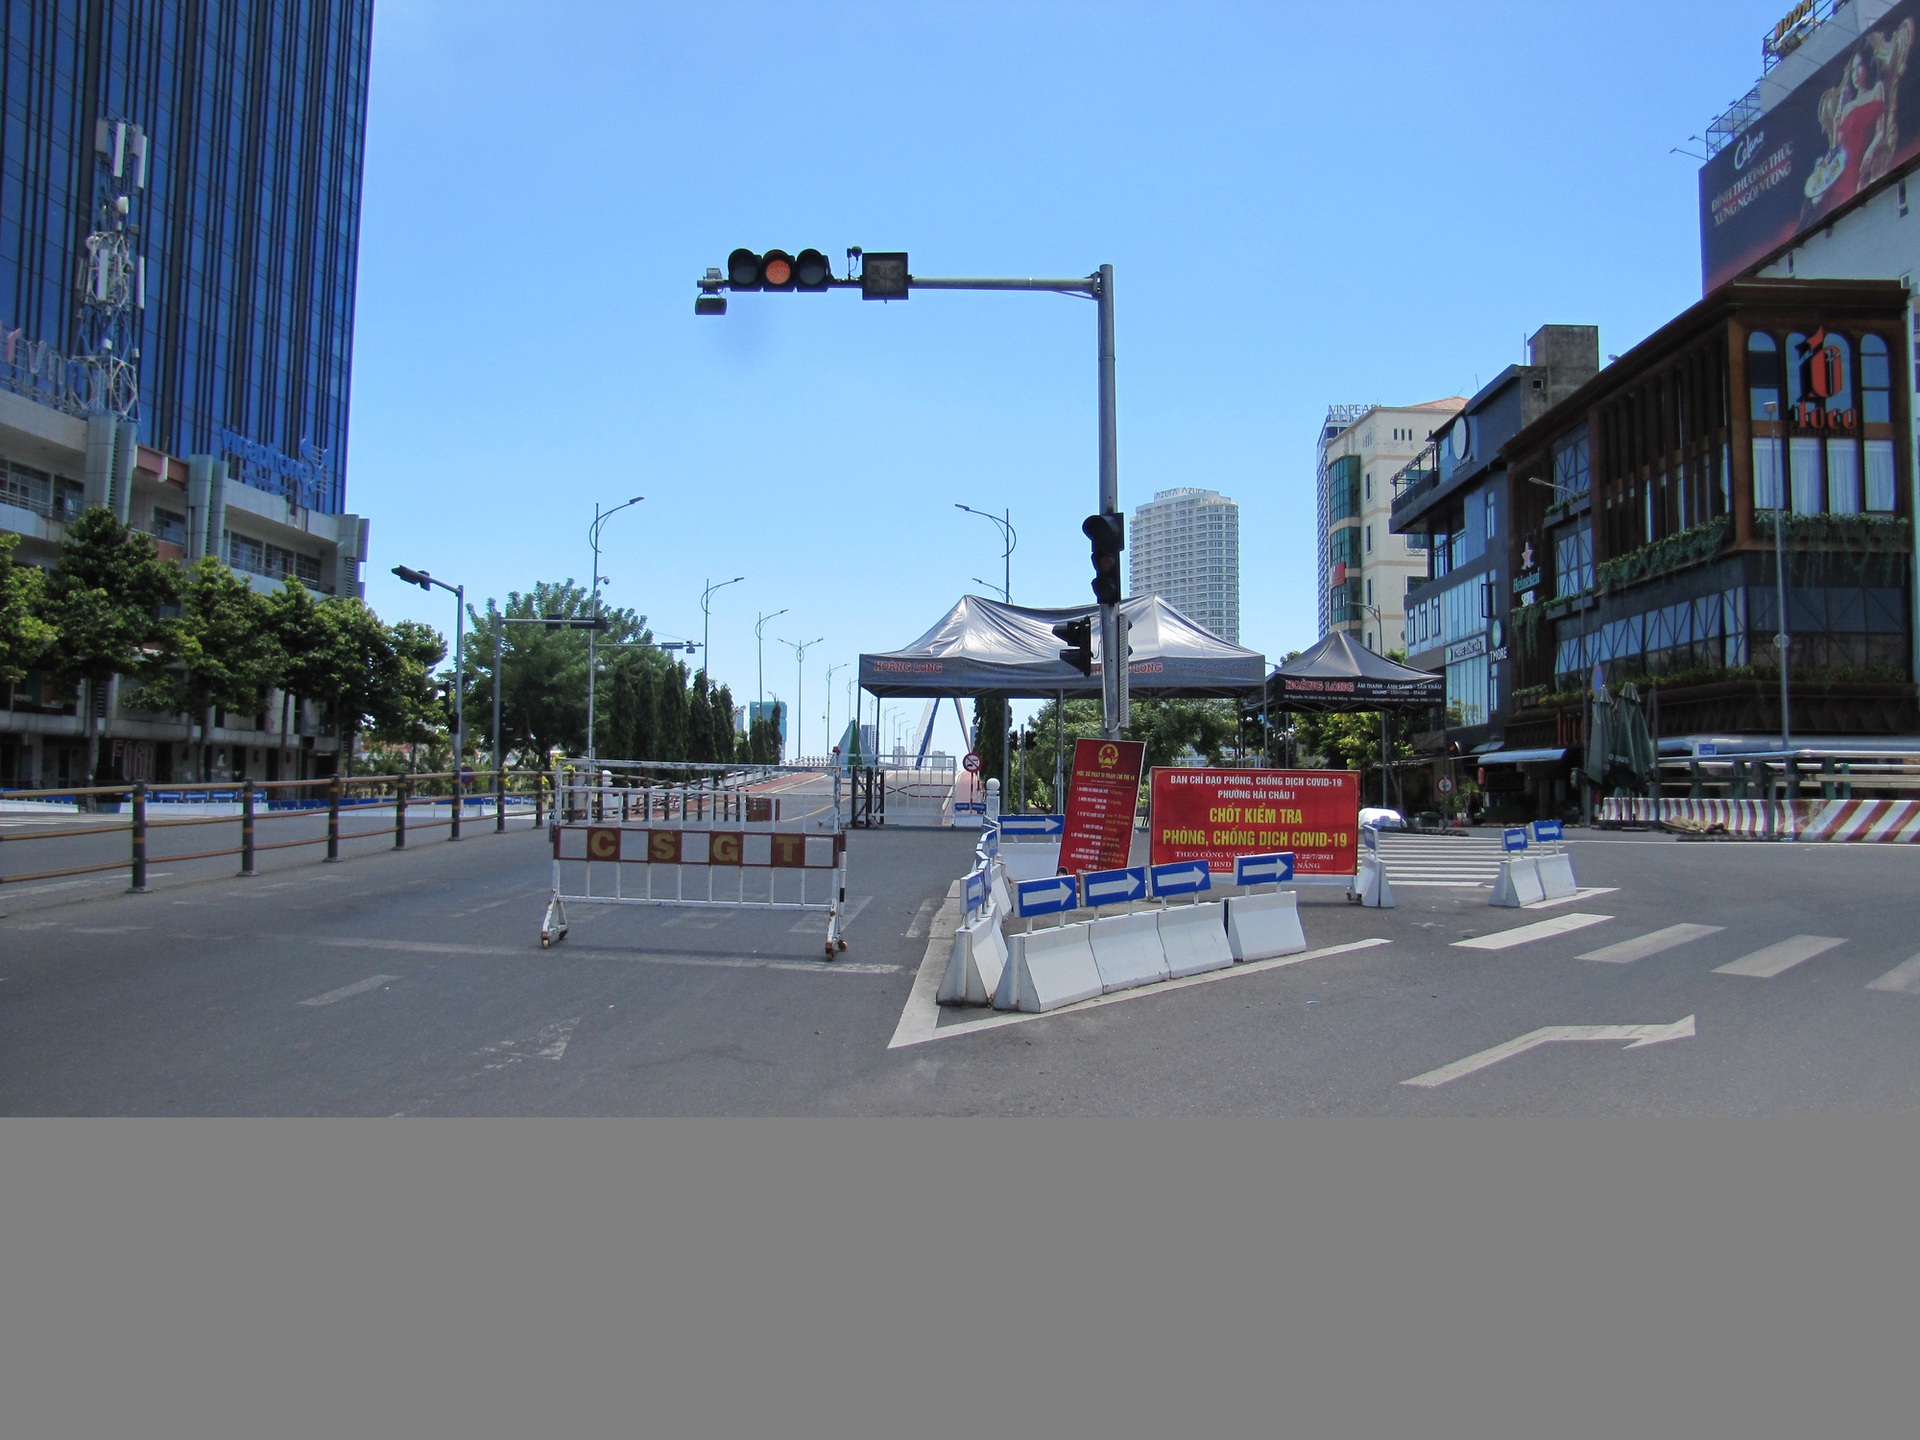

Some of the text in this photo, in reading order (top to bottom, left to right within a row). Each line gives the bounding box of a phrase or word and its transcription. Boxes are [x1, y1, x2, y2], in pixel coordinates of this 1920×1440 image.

[1513, 567, 1540, 593] Heineken
[874, 661, 911, 672] HOÀNG
[913, 662, 942, 672] LONG
[1133, 663, 1163, 673] LONG
[1285, 678, 1323, 690] HOÀNG
[1325, 681, 1355, 692] LONG
[1170, 774, 1342, 788] BAN CHỈ ĐẠO PHÒNG, CHỐNG DỊCH COVID-19
[1218, 788, 1250, 799] PHƯỜNG
[1253, 788, 1266, 799] HẢI
[1268, 788, 1290, 799] CHÂU
[1209, 802, 1303, 824] CHỐT KIỂM TRA
[1163, 825, 1347, 849] PHÒNG, CHỐNG DỊCH COVID-19
[1200, 850, 1224, 858] CÔNG
